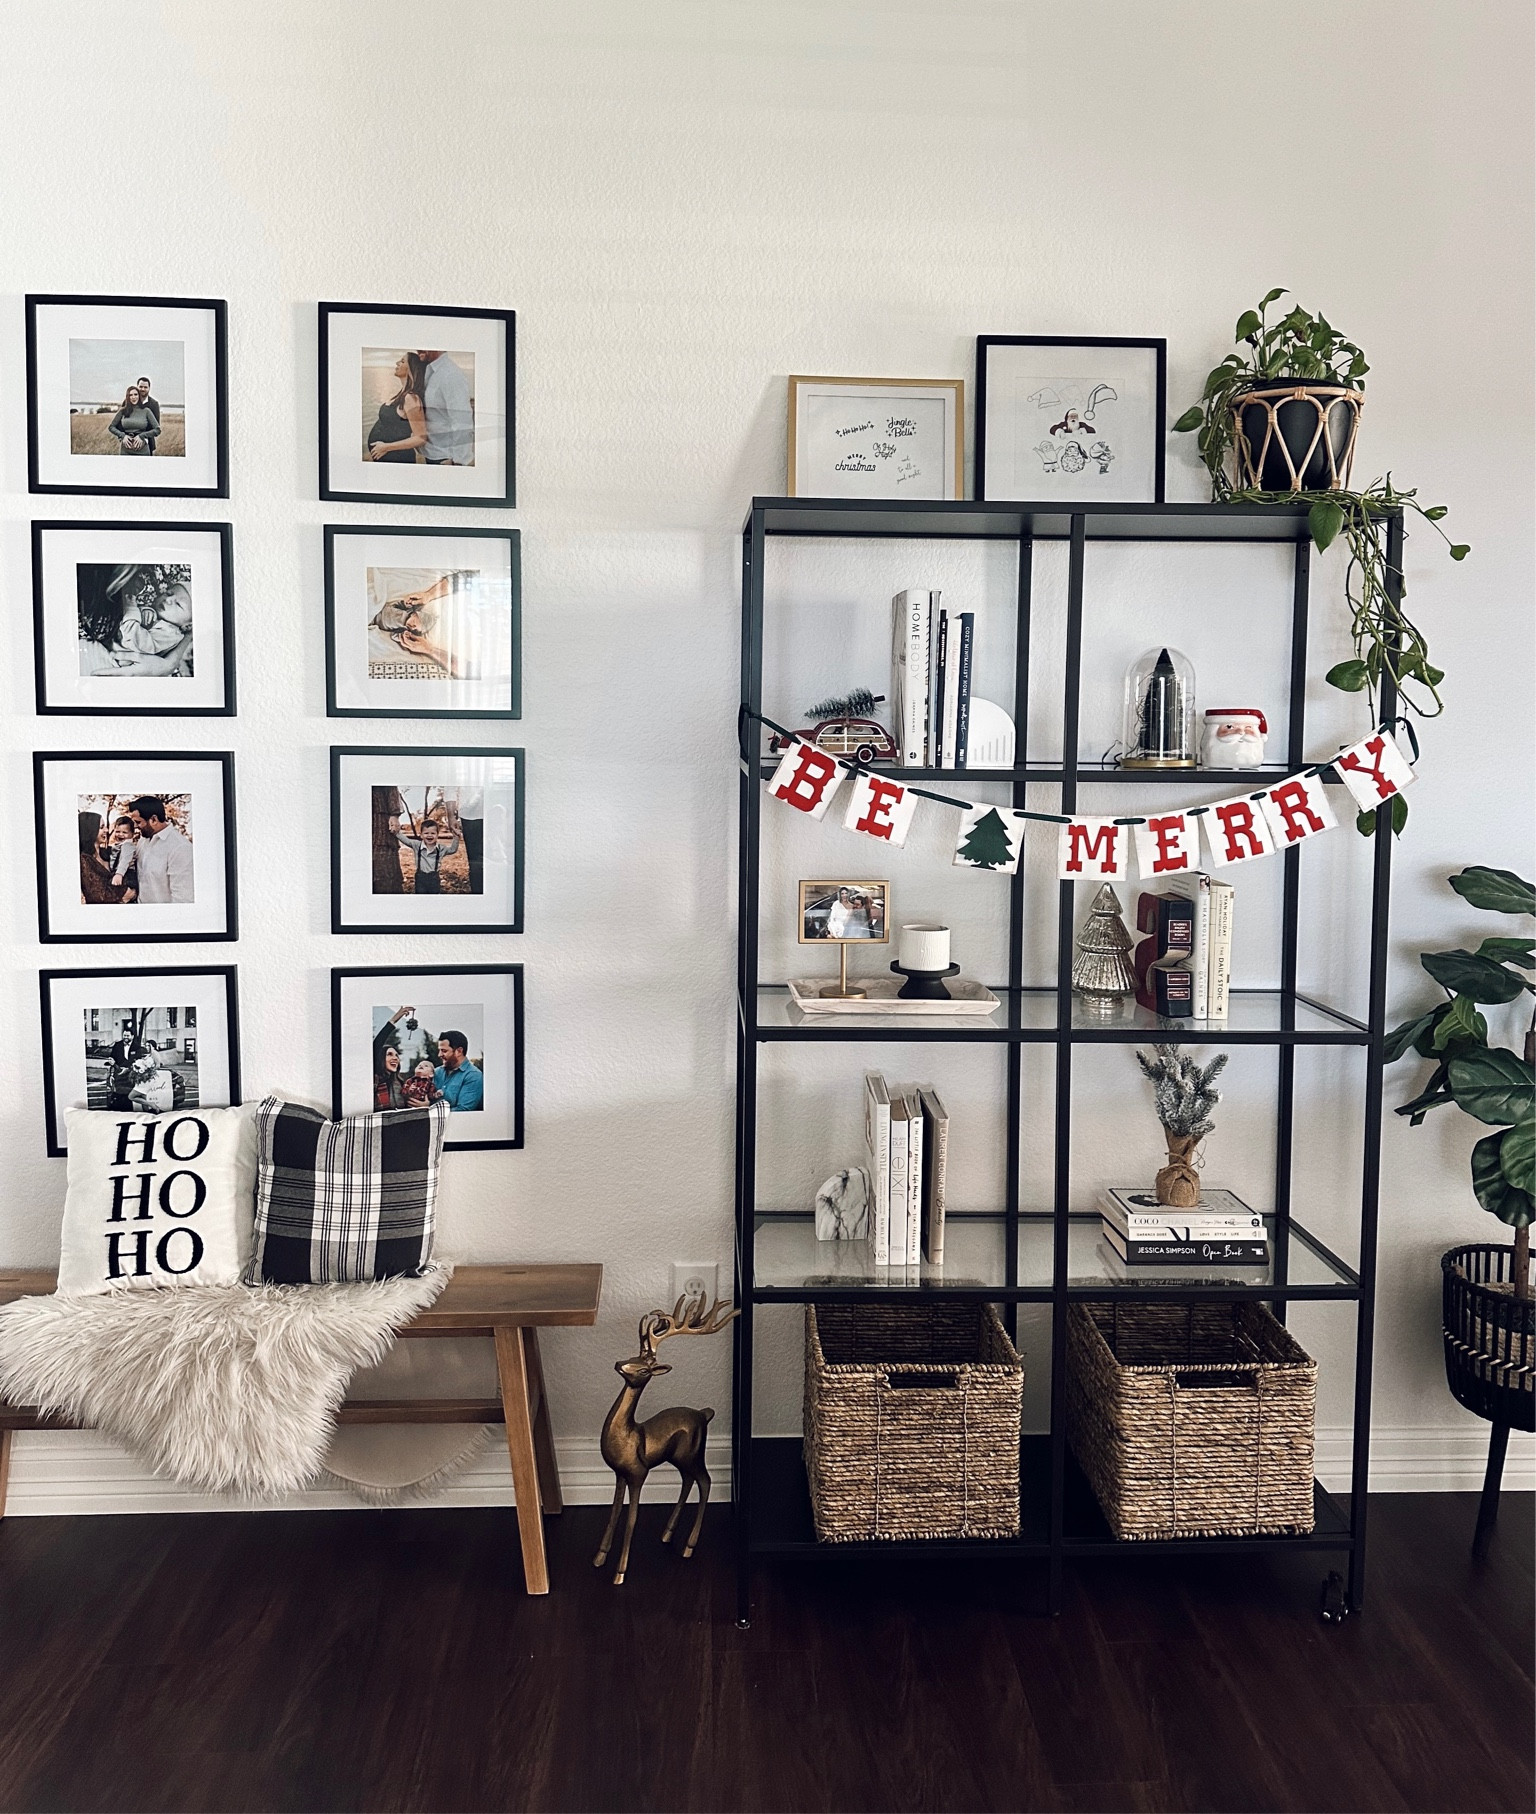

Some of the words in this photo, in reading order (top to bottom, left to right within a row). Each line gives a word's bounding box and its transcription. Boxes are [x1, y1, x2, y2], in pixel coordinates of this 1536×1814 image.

[888, 416, 912, 429] Jingle
[891, 427, 913, 438] Bells
[834, 459, 876, 472] christmas
[910, 603, 921, 680] HOMEBODY
[775, 744, 904, 840] BE
[1066, 736, 1398, 874] MERRY
[110, 1117, 210, 1166] HO
[939, 1127, 948, 1160] LAUREN
[892, 1156, 906, 1199] elixir
[937, 1161, 946, 1194] CONRAD
[106, 1170, 206, 1222] HO
[935, 1197, 945, 1226] Beauty
[105, 1227, 204, 1280] HO
[1202, 1244, 1221, 1260] Open
[1223, 1244, 1243, 1258] Book
